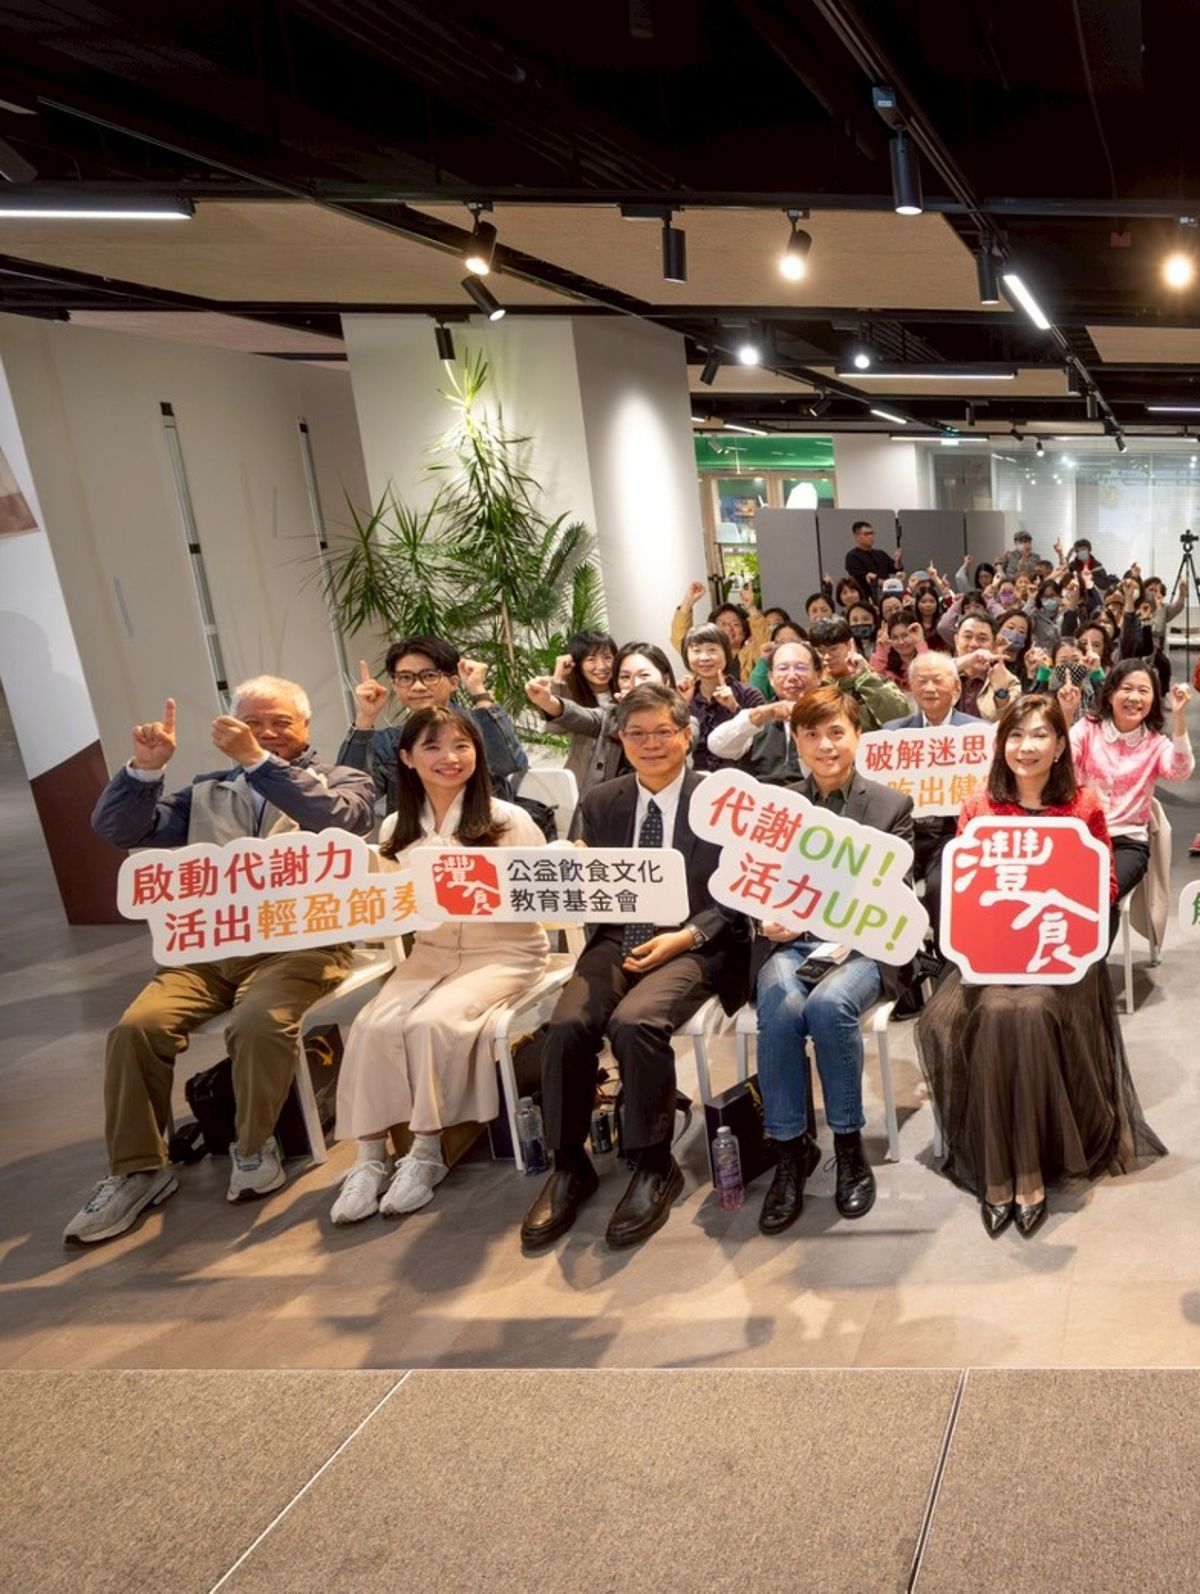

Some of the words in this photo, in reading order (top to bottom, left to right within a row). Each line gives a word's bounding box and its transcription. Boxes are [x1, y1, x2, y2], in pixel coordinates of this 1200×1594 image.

[865, 734, 987, 772] 破解迷思
[132, 841, 353, 906] 啟動代謝力
[507, 859, 663, 883] 公益飲食文化
[510, 888, 639, 913] 教育基金會
